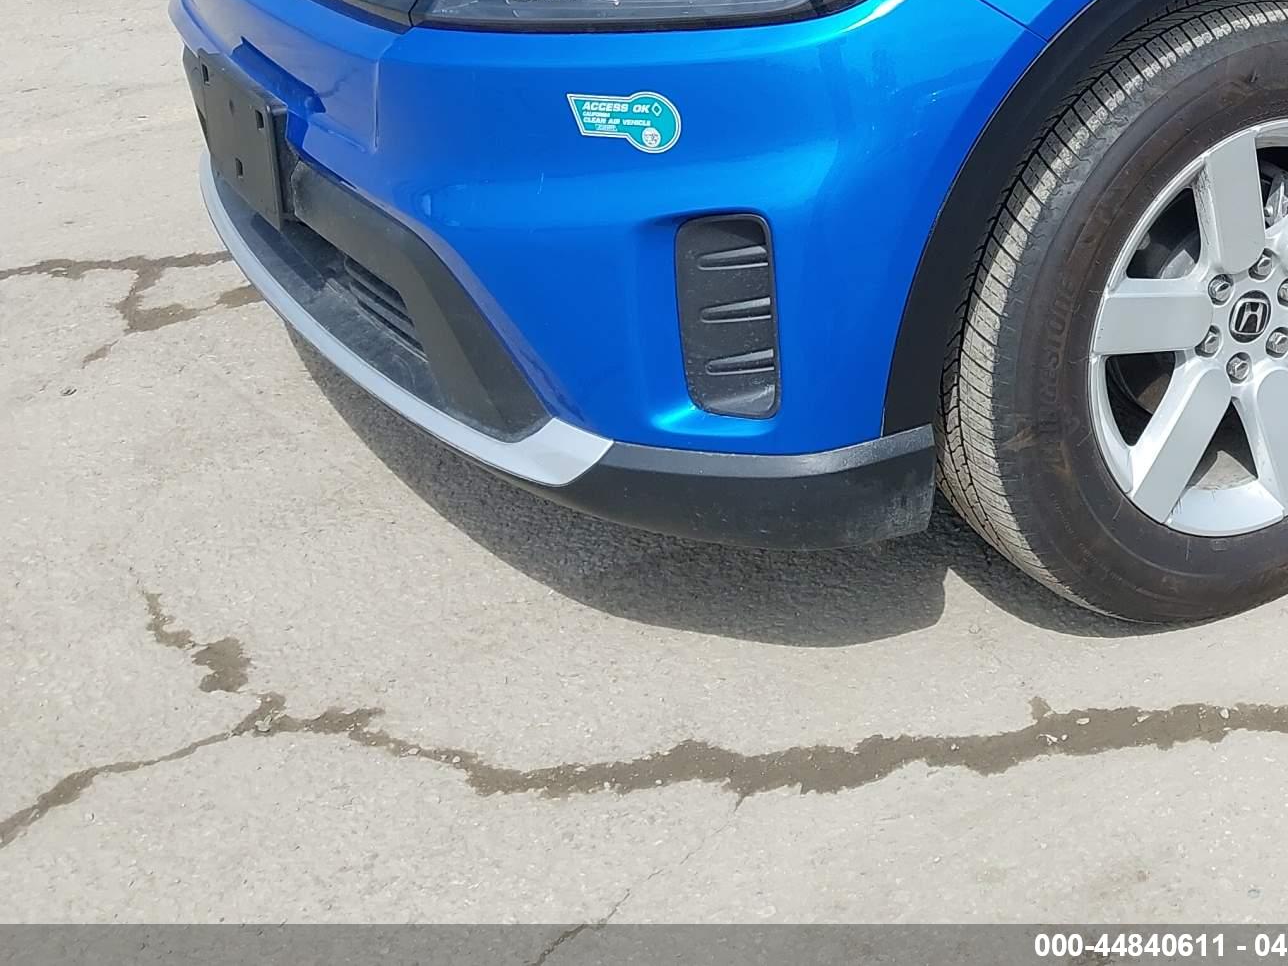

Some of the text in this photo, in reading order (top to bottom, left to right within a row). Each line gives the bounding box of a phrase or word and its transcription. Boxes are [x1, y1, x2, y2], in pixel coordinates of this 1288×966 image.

[581, 101, 651, 114] ACCESS OK
[622, 119, 651, 127] VEHICLE
